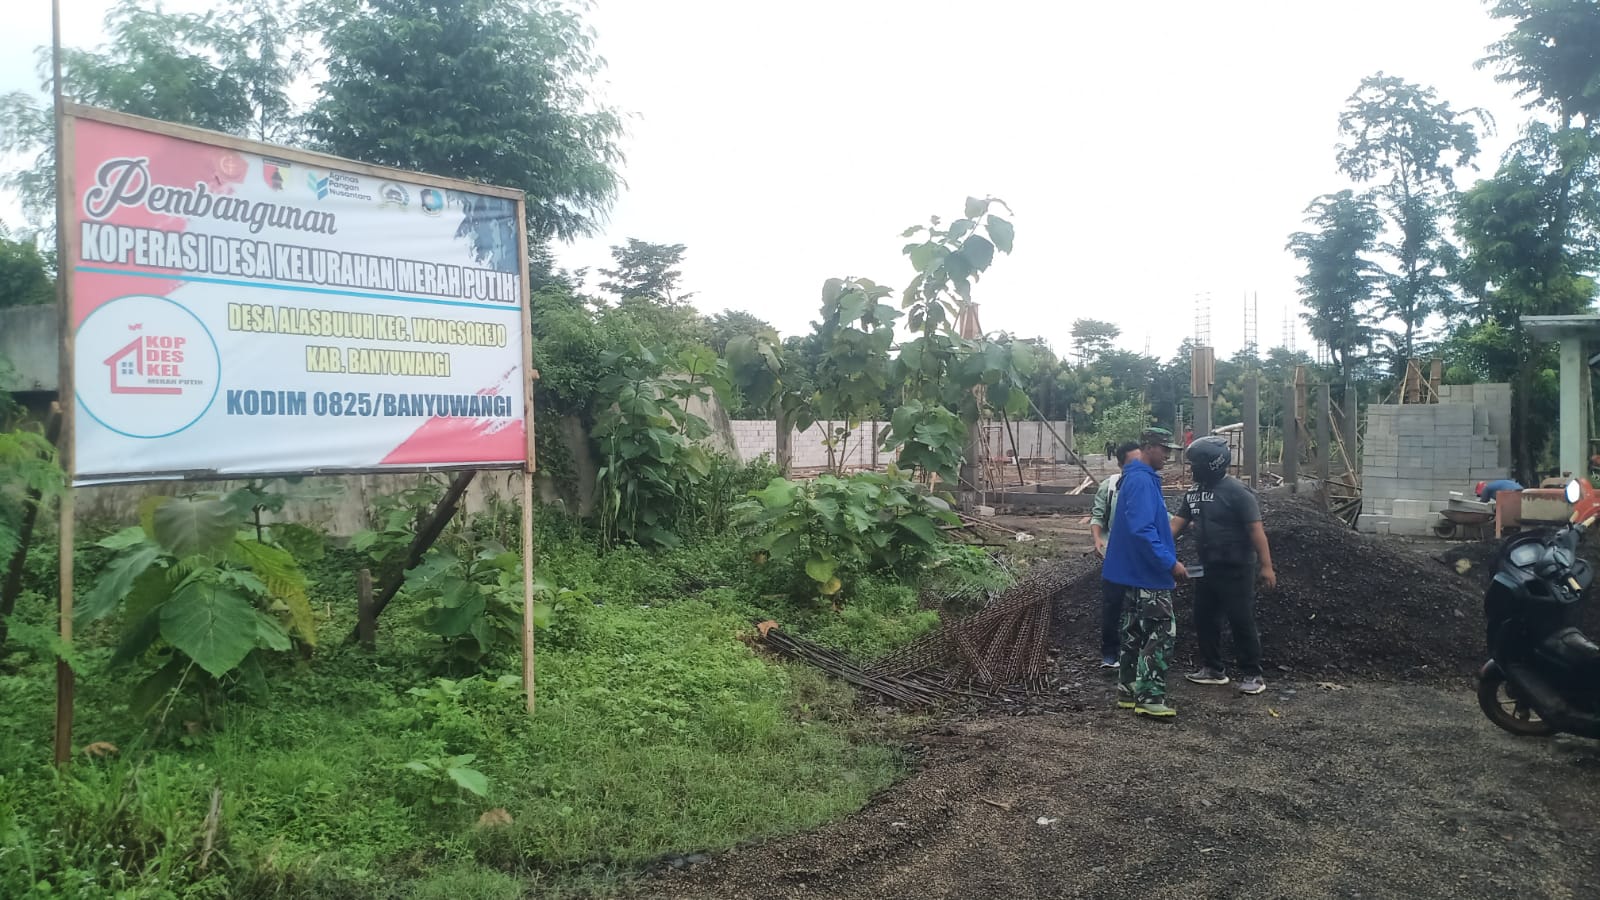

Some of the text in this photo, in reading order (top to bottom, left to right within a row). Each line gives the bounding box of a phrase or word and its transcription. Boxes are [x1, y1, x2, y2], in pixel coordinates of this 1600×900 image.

[85, 158, 337, 234] Pembangunan
[329, 180, 359, 191] Pangan
[329, 188, 372, 200] Nusantara
[81, 221, 516, 303] KOPERASI DESA KELURAHAN MERAH PUTIH
[227, 303, 507, 348] DESA ALASBULUH KEC. WONGSOREJO
[146, 336, 186, 349] KOP
[146, 349, 184, 363] DES
[305, 345, 451, 377] KAB. BANYUWANGI
[147, 364, 182, 376] KEL
[227, 389, 512, 418] KODIM 0825/BANYUWANGI
